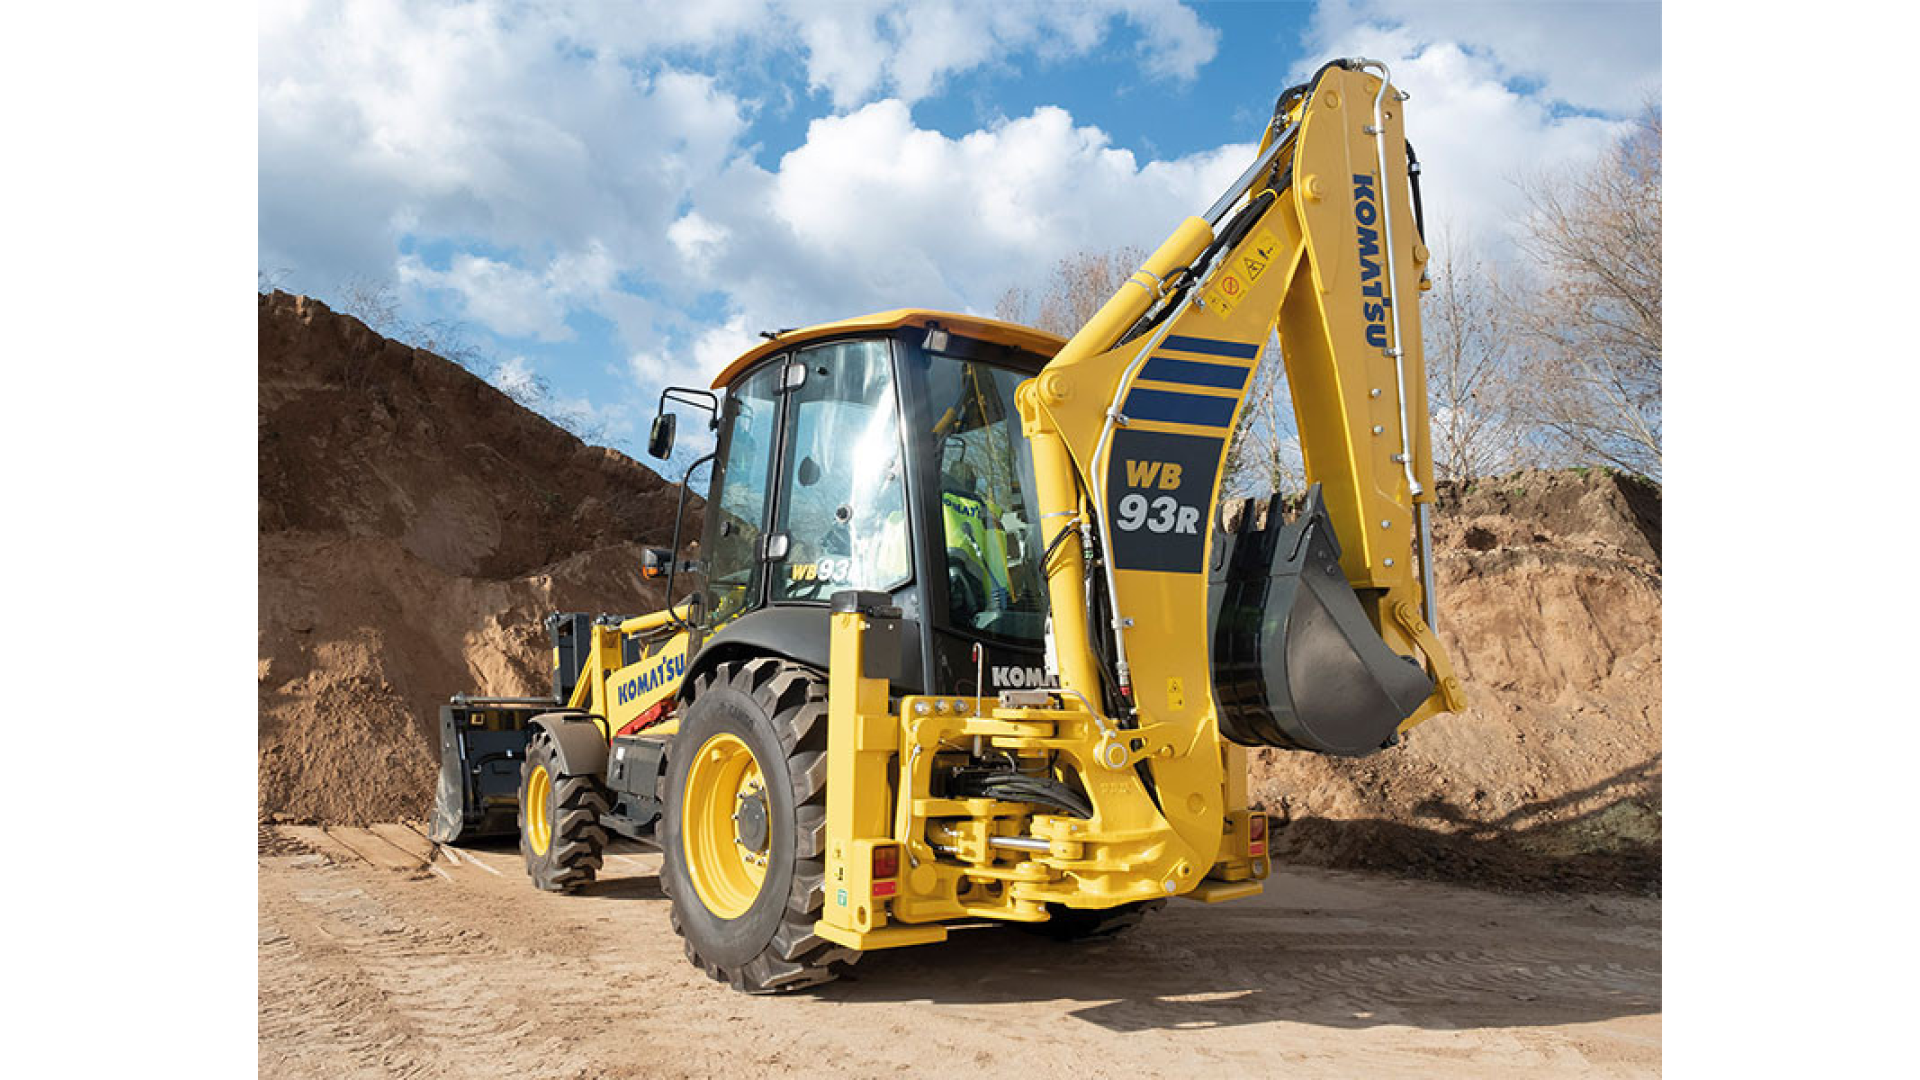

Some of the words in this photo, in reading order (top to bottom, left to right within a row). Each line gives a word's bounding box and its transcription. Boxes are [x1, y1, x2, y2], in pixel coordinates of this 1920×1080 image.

[1352, 173, 1391, 348] KOMATSU
[1126, 459, 1183, 491] WB
[1117, 493, 1200, 534] 93R
[617, 653, 685, 706] KOMATSU
